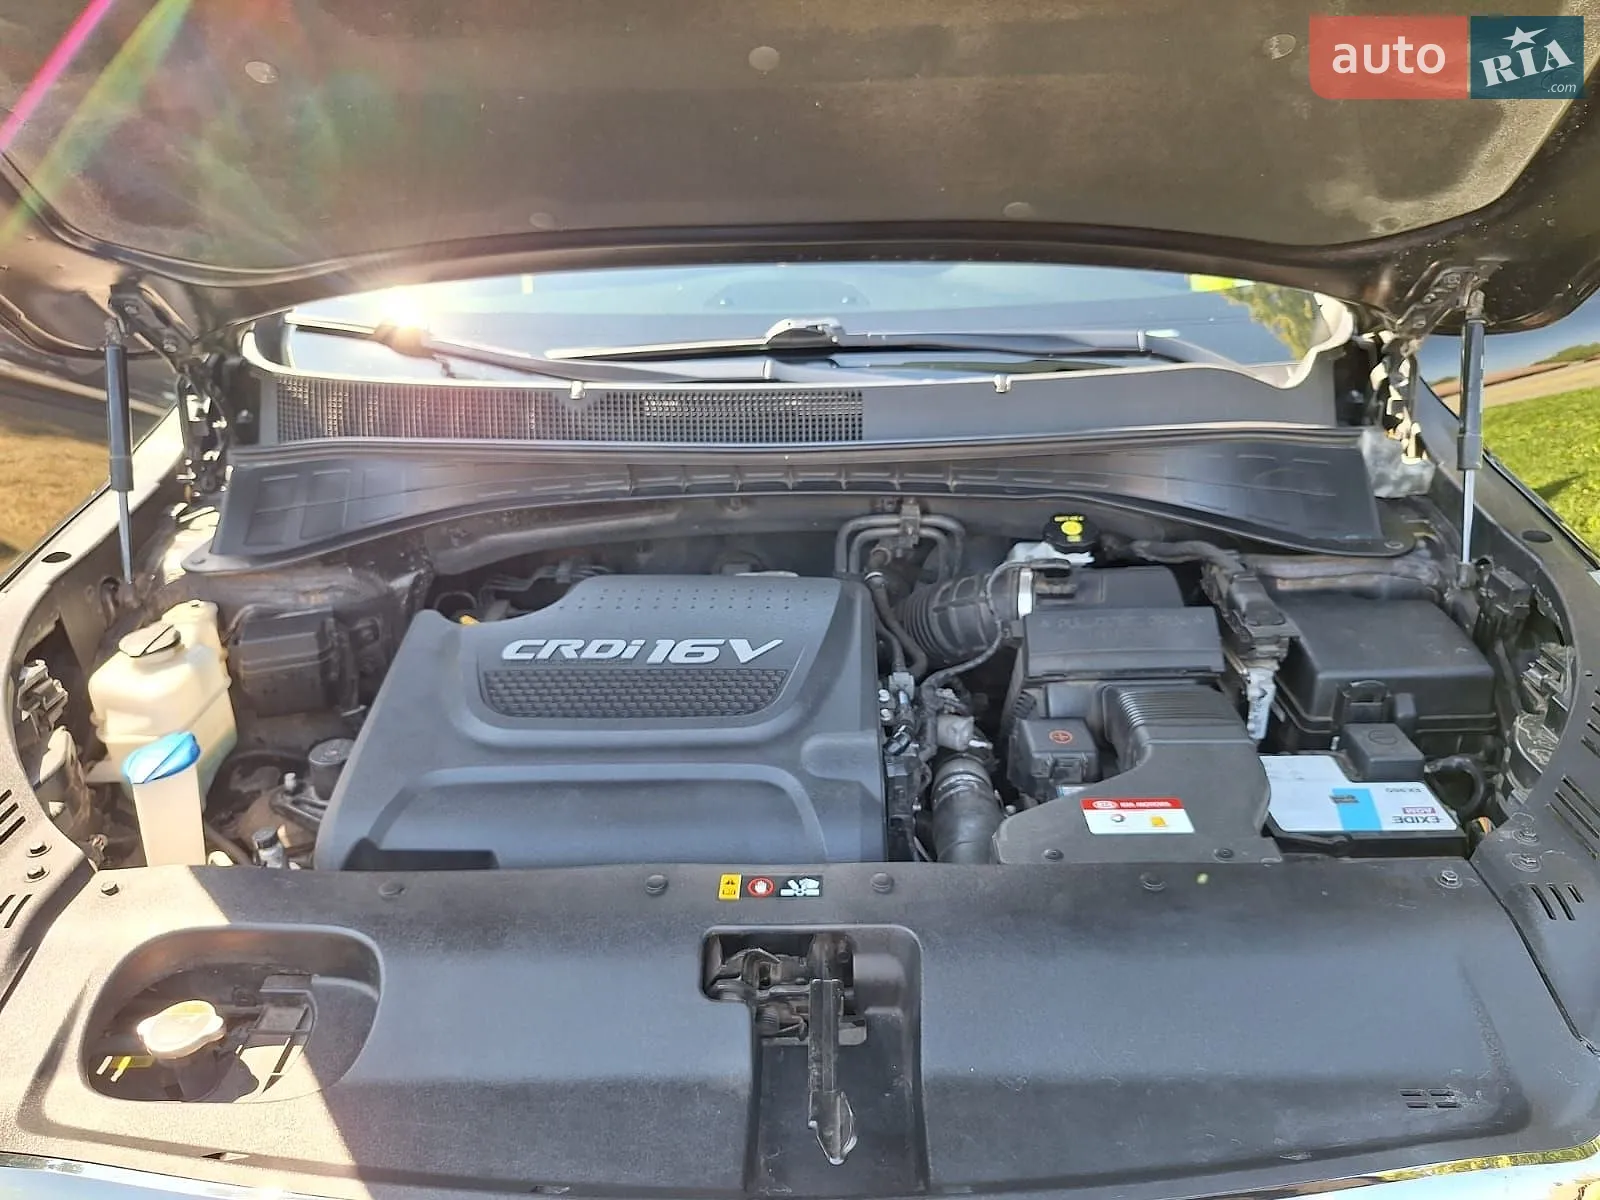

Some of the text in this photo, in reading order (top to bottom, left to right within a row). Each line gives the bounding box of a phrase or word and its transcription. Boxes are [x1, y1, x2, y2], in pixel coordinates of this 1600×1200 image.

[501, 639, 784, 664] CRDi 16V
[1392, 815, 1443, 824] EXIDE
